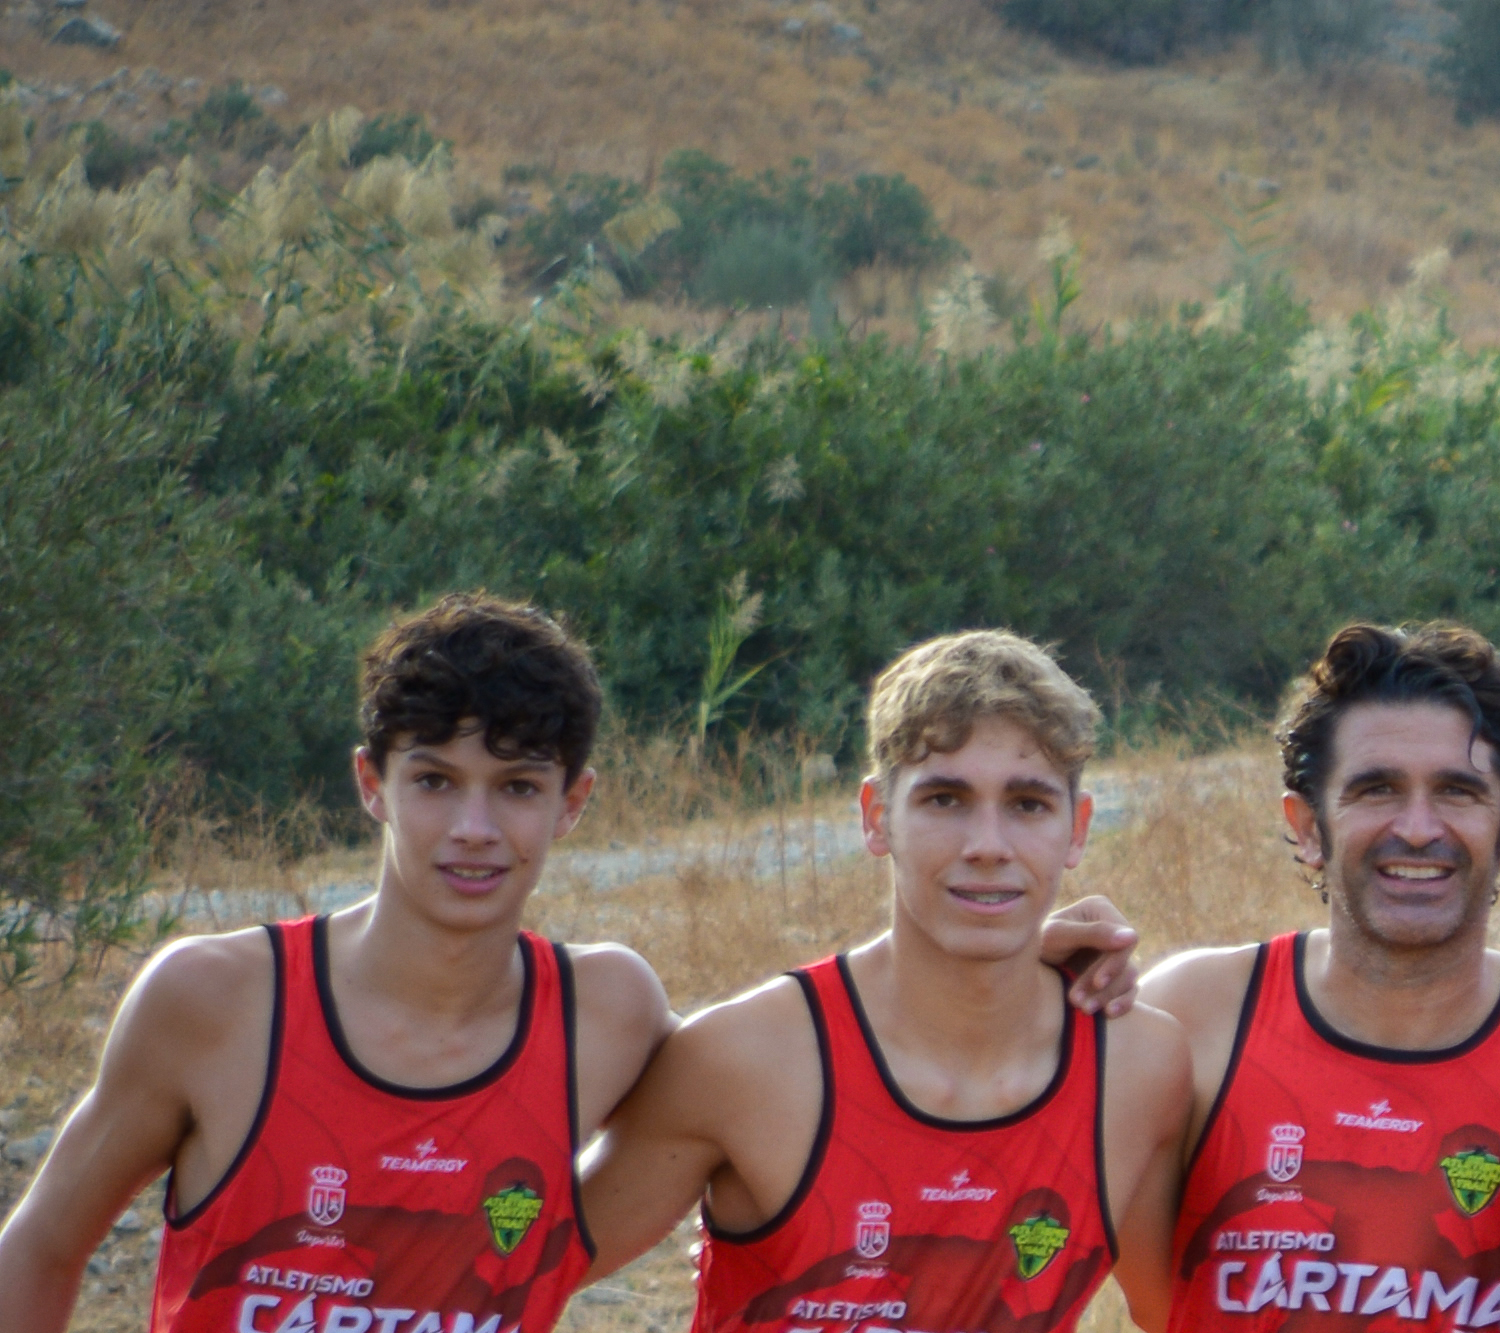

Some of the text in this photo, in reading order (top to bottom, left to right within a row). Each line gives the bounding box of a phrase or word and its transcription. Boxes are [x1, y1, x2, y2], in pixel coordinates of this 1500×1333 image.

[1335, 1111, 1424, 1133] TEAMERGY
[380, 1155, 467, 1173] TEAMERGY
[920, 1187, 997, 1202] TEAMERGY
[1215, 1230, 1336, 1252] ATLETISMO
[245, 1264, 375, 1298] ATLETISMO
[790, 1299, 907, 1320] ATLETISMO
